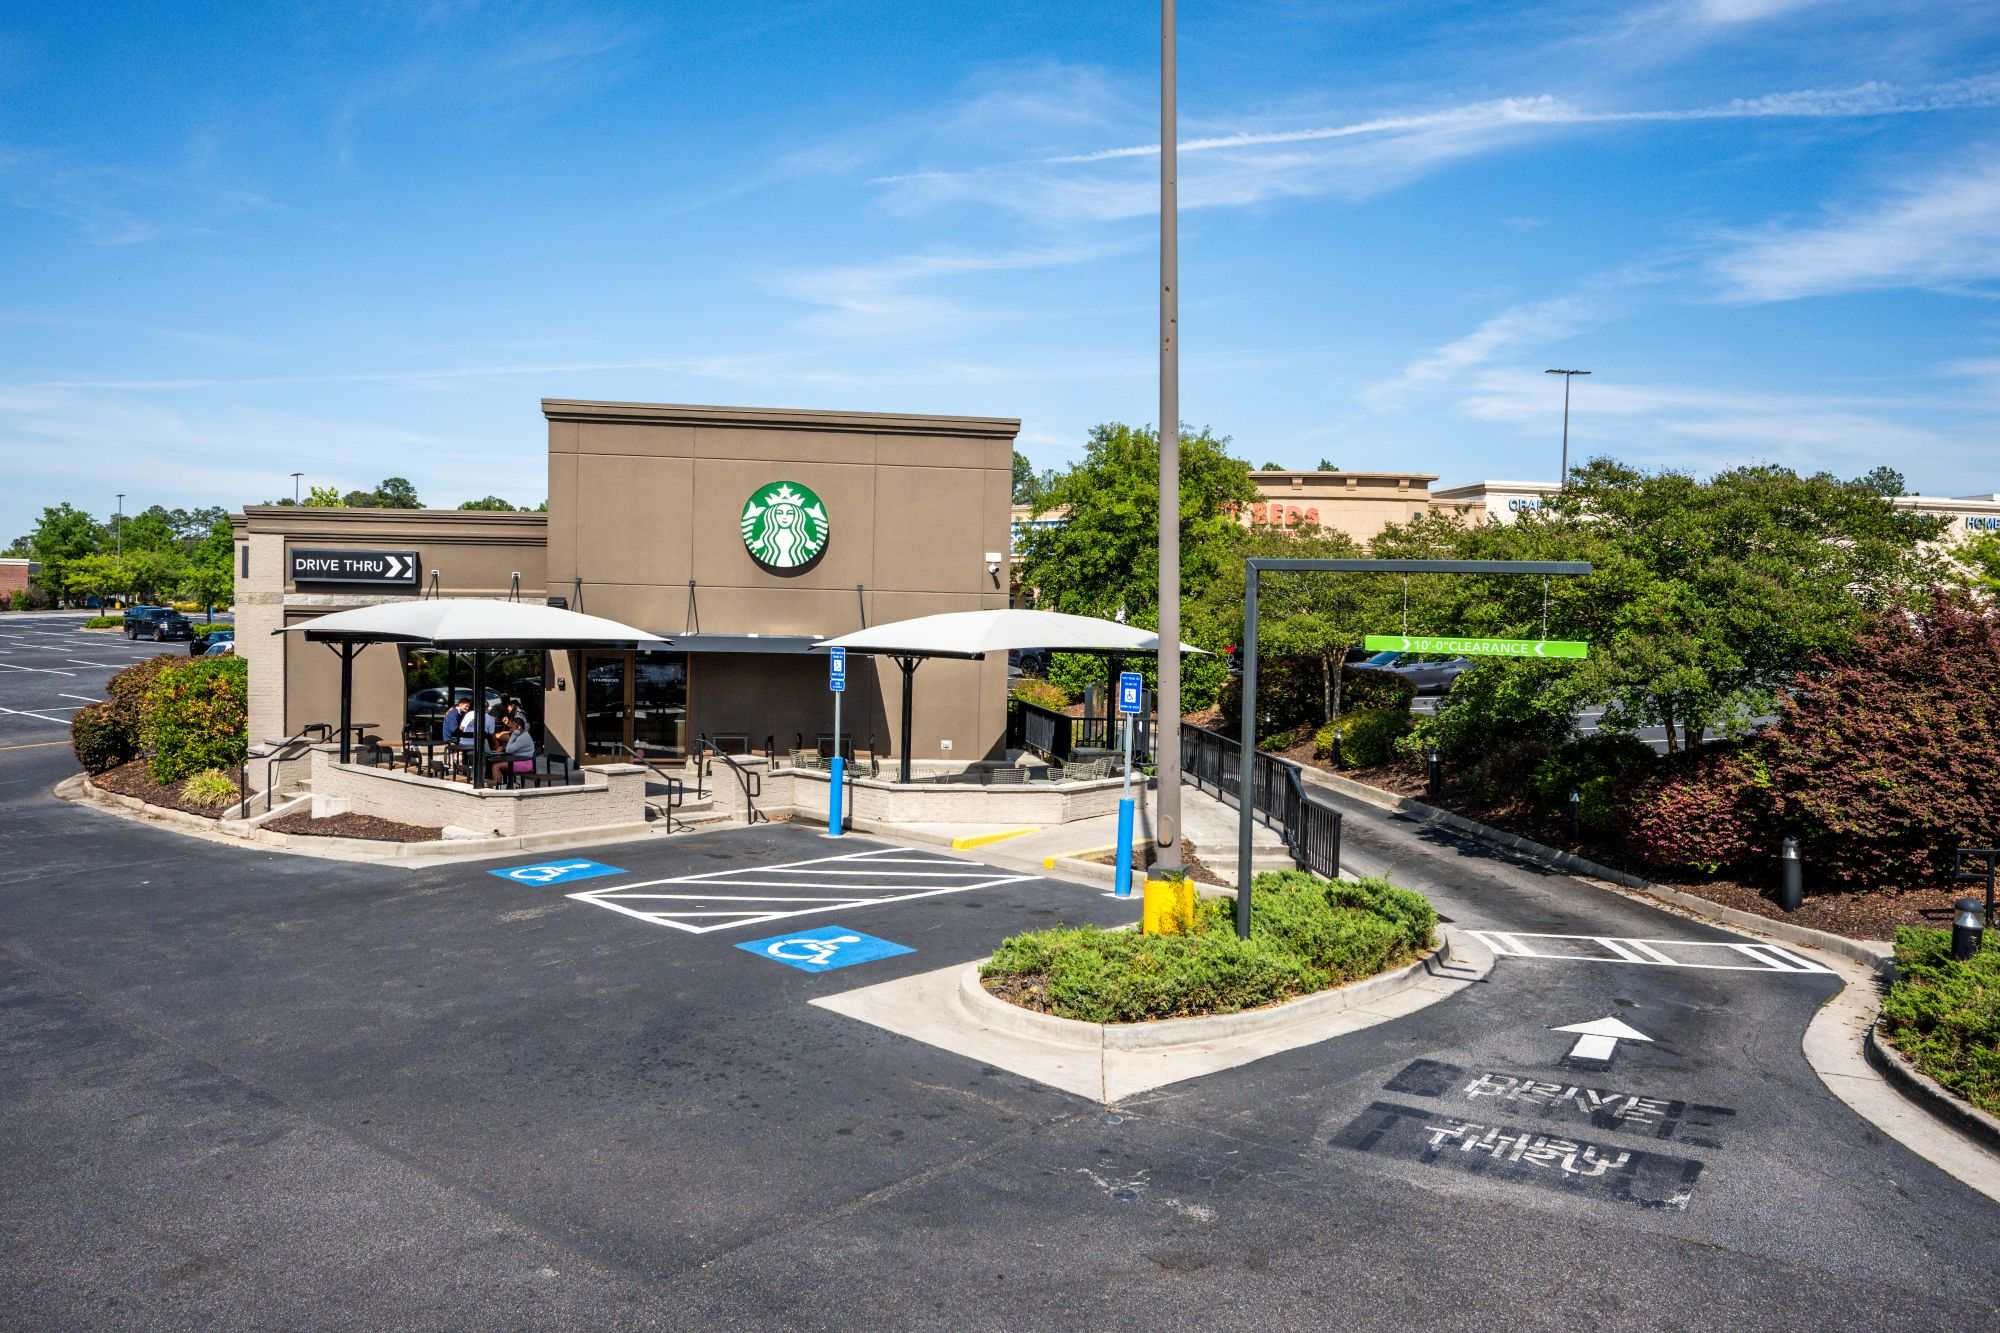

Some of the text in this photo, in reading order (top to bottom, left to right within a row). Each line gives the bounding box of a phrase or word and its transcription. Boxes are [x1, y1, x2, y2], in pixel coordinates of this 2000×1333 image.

[295, 558, 383, 572] DRIVE THRU
[1449, 641, 1529, 655] CLEARANCE
